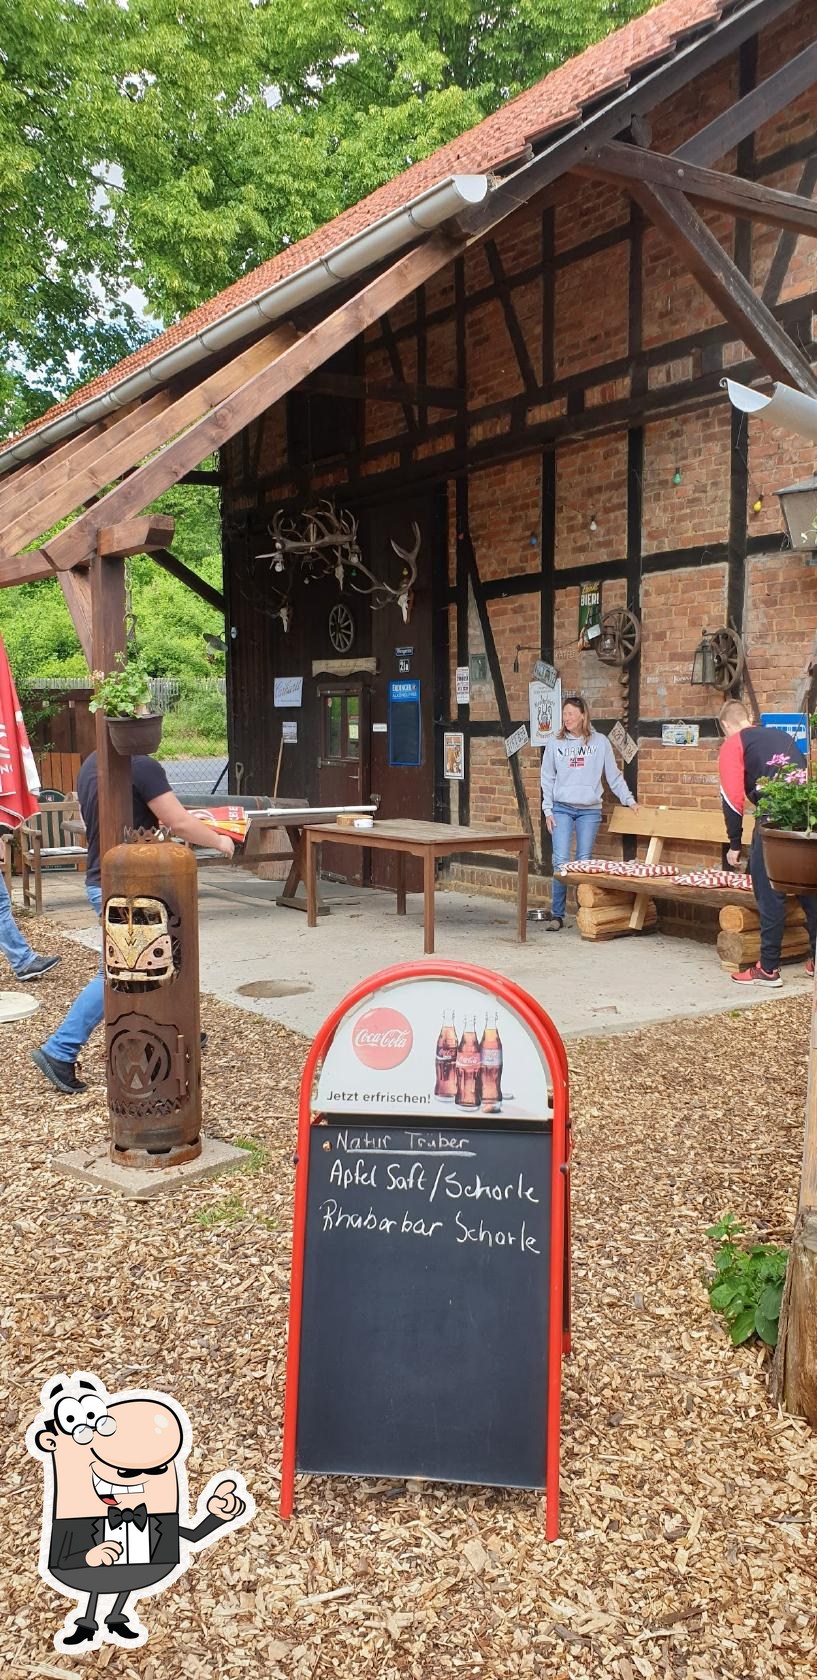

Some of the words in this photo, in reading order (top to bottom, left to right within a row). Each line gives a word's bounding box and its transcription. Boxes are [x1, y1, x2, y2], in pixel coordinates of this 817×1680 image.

[556, 745, 598, 758] NORWAY
[355, 1028, 411, 1049] Coca-Cola
[326, 1090, 359, 1101] Jetzt
[362, 1091, 431, 1104] erfrischen!
[336, 1129, 392, 1150] Natur
[404, 1131, 470, 1150] Trüber
[329, 1158, 377, 1189] Apfel
